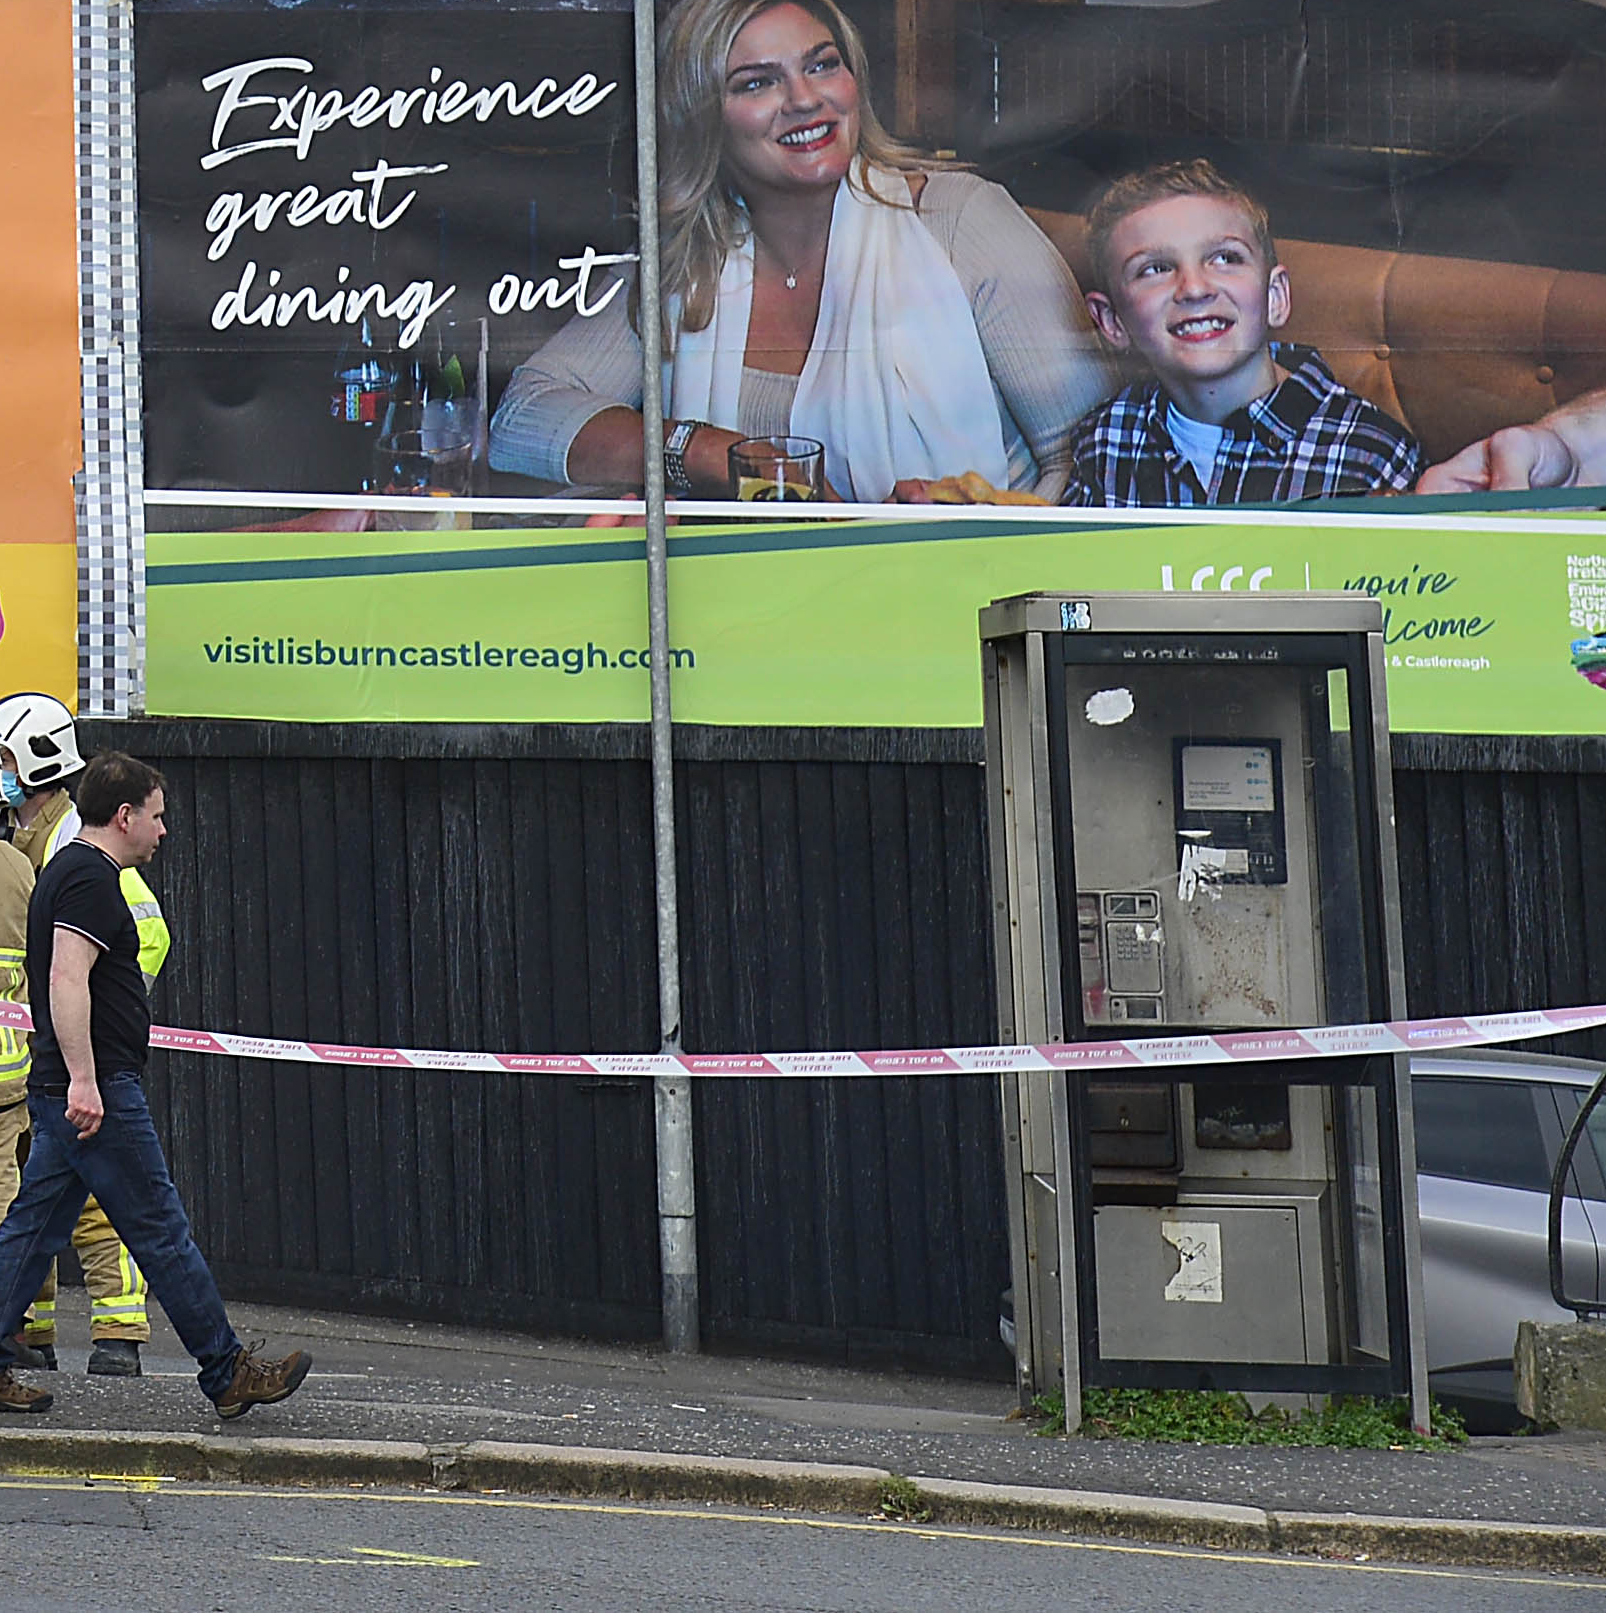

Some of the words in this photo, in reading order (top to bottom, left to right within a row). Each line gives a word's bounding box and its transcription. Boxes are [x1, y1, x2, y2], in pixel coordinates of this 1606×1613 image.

[200, 57, 617, 170] Experience
[205, 159, 448, 262] great
[211, 262, 456, 350] dining
[489, 246, 640, 317] out
[1382, 608, 1496, 645] lcome
[1391, 655, 1401, 668] &
[1405, 655, 1490, 671] Castlereagh
